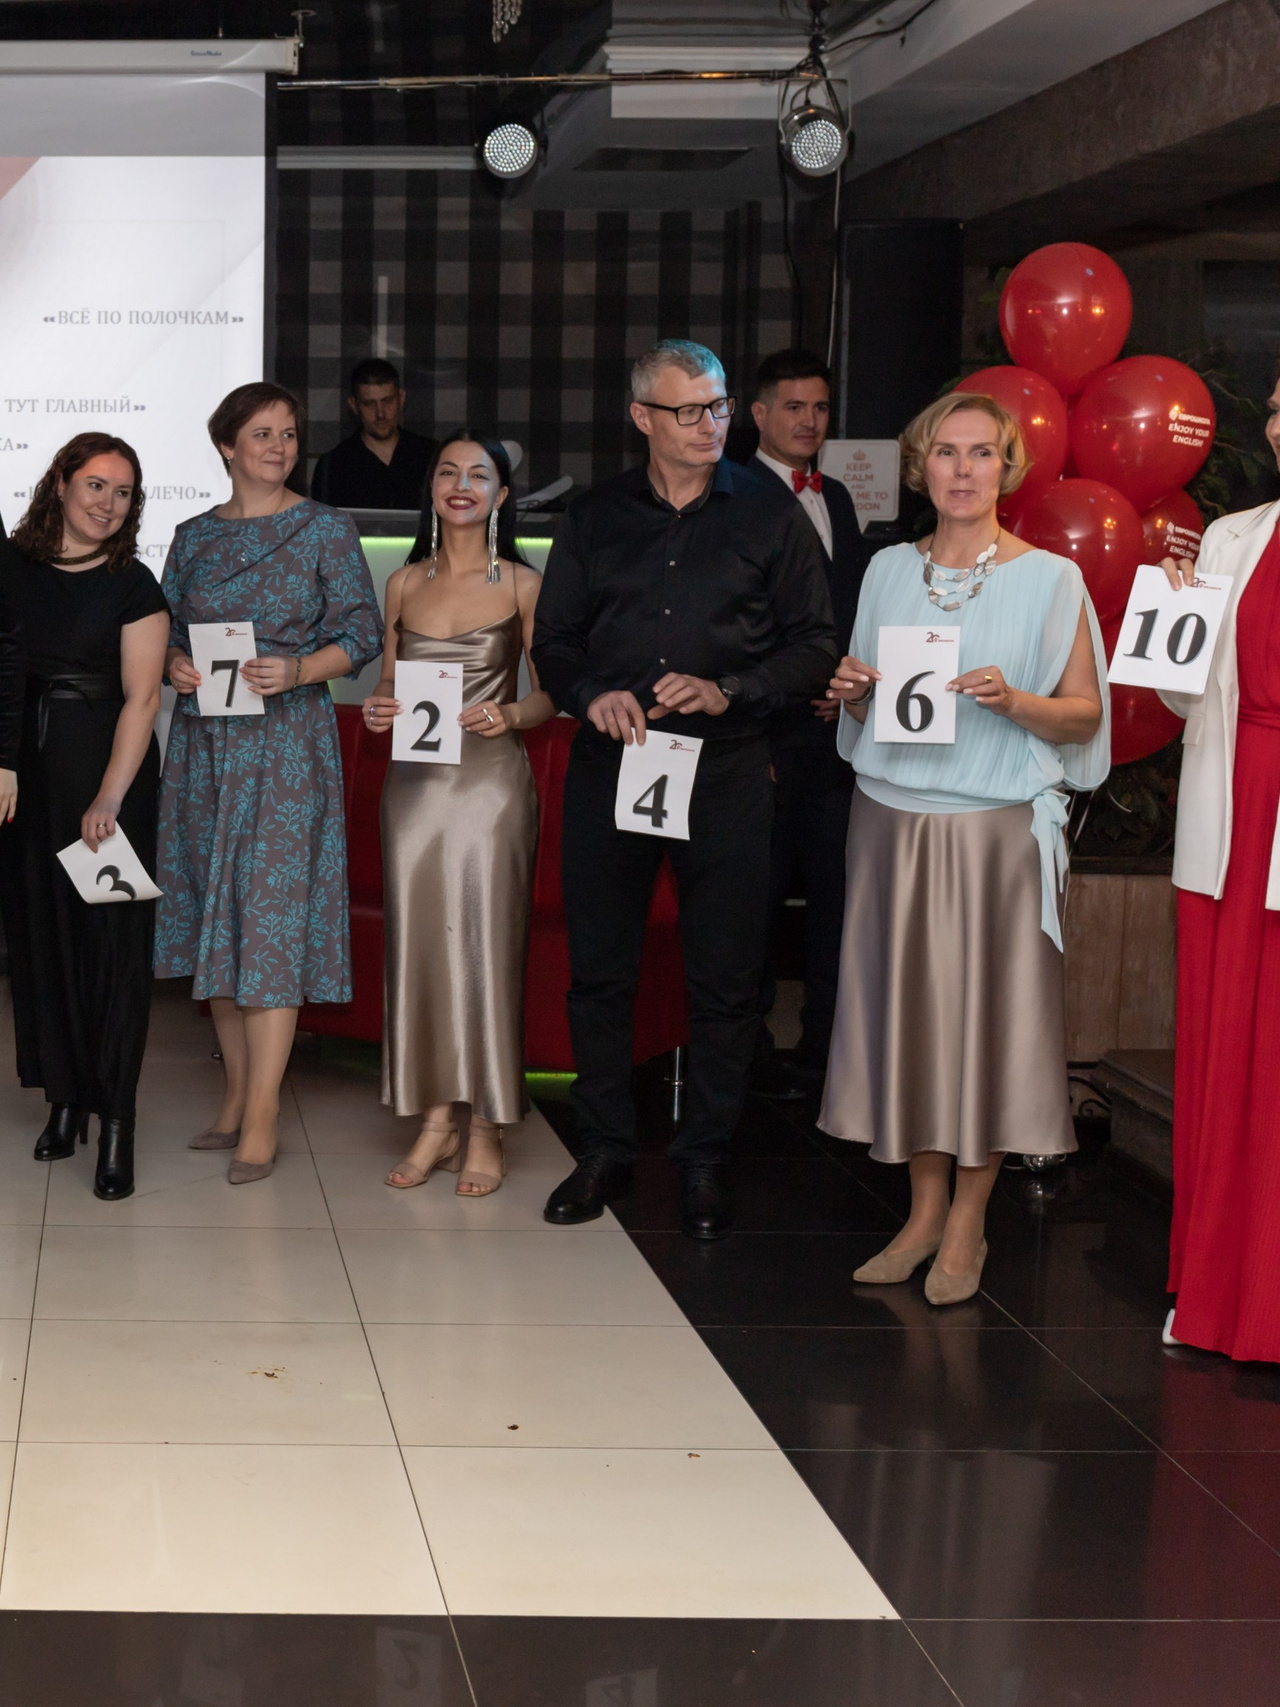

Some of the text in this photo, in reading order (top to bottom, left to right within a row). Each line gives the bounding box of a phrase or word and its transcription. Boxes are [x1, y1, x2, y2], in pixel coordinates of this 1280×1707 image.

[97, 311, 121, 325] ПО
[4, 398, 39, 413] ТУТ
[1168, 422, 1195, 435] ENJOY
[846, 462, 872, 471] KEEP
[843, 473, 874, 482] CALM
[856, 492, 871, 500] ME
[875, 491, 888, 500] TO
[854, 502, 880, 511] DON
[1123, 608, 1207, 666] 10
[210, 659, 240, 708] 7
[896, 670, 936, 733] 6
[410, 700, 442, 753] 2
[632, 774, 668, 829] 4
[96, 864, 136, 900] 3
